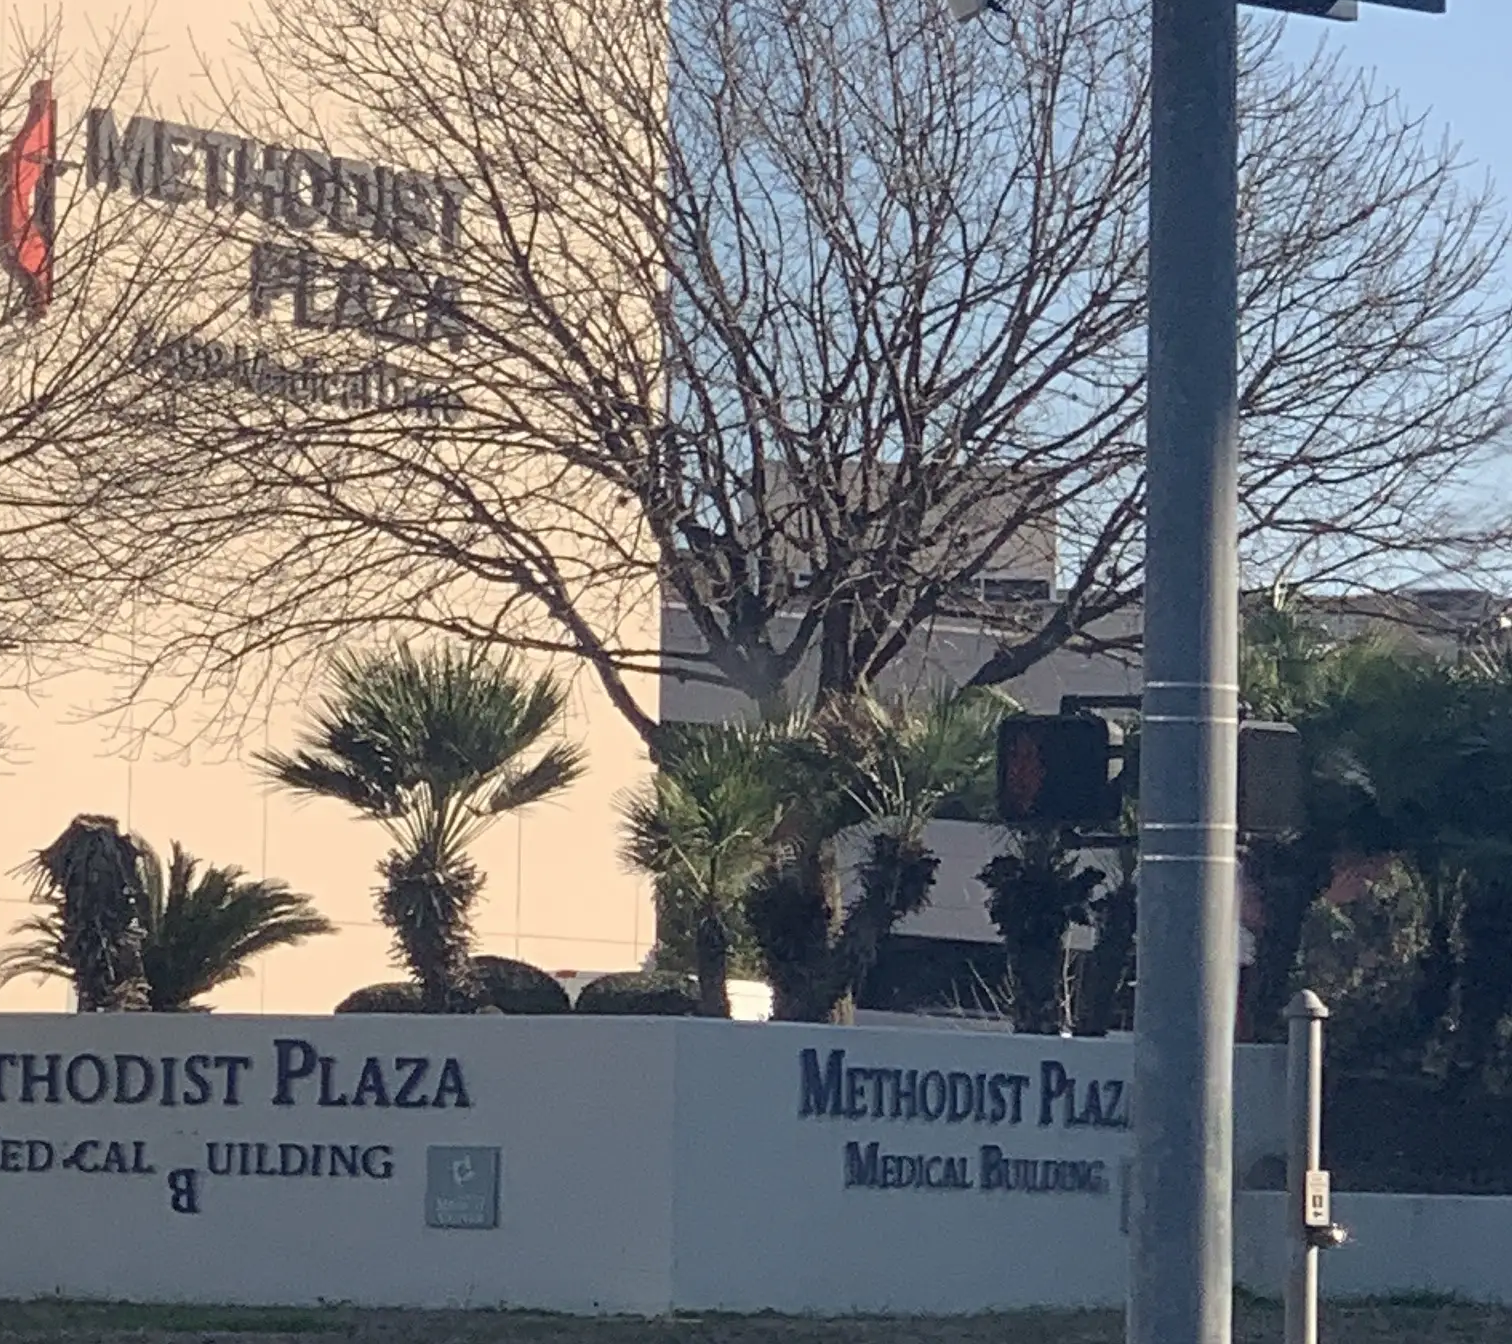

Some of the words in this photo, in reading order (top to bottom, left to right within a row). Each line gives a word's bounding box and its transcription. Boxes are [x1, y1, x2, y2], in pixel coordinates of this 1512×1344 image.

[86, 106, 470, 254] METHODIST
[271, 1037, 474, 1110] PLAZA
[797, 1048, 1031, 1125] METHODIST
[1036, 1059, 1136, 1129] PLAZ
[844, 1140, 974, 1190] MEDICAL
